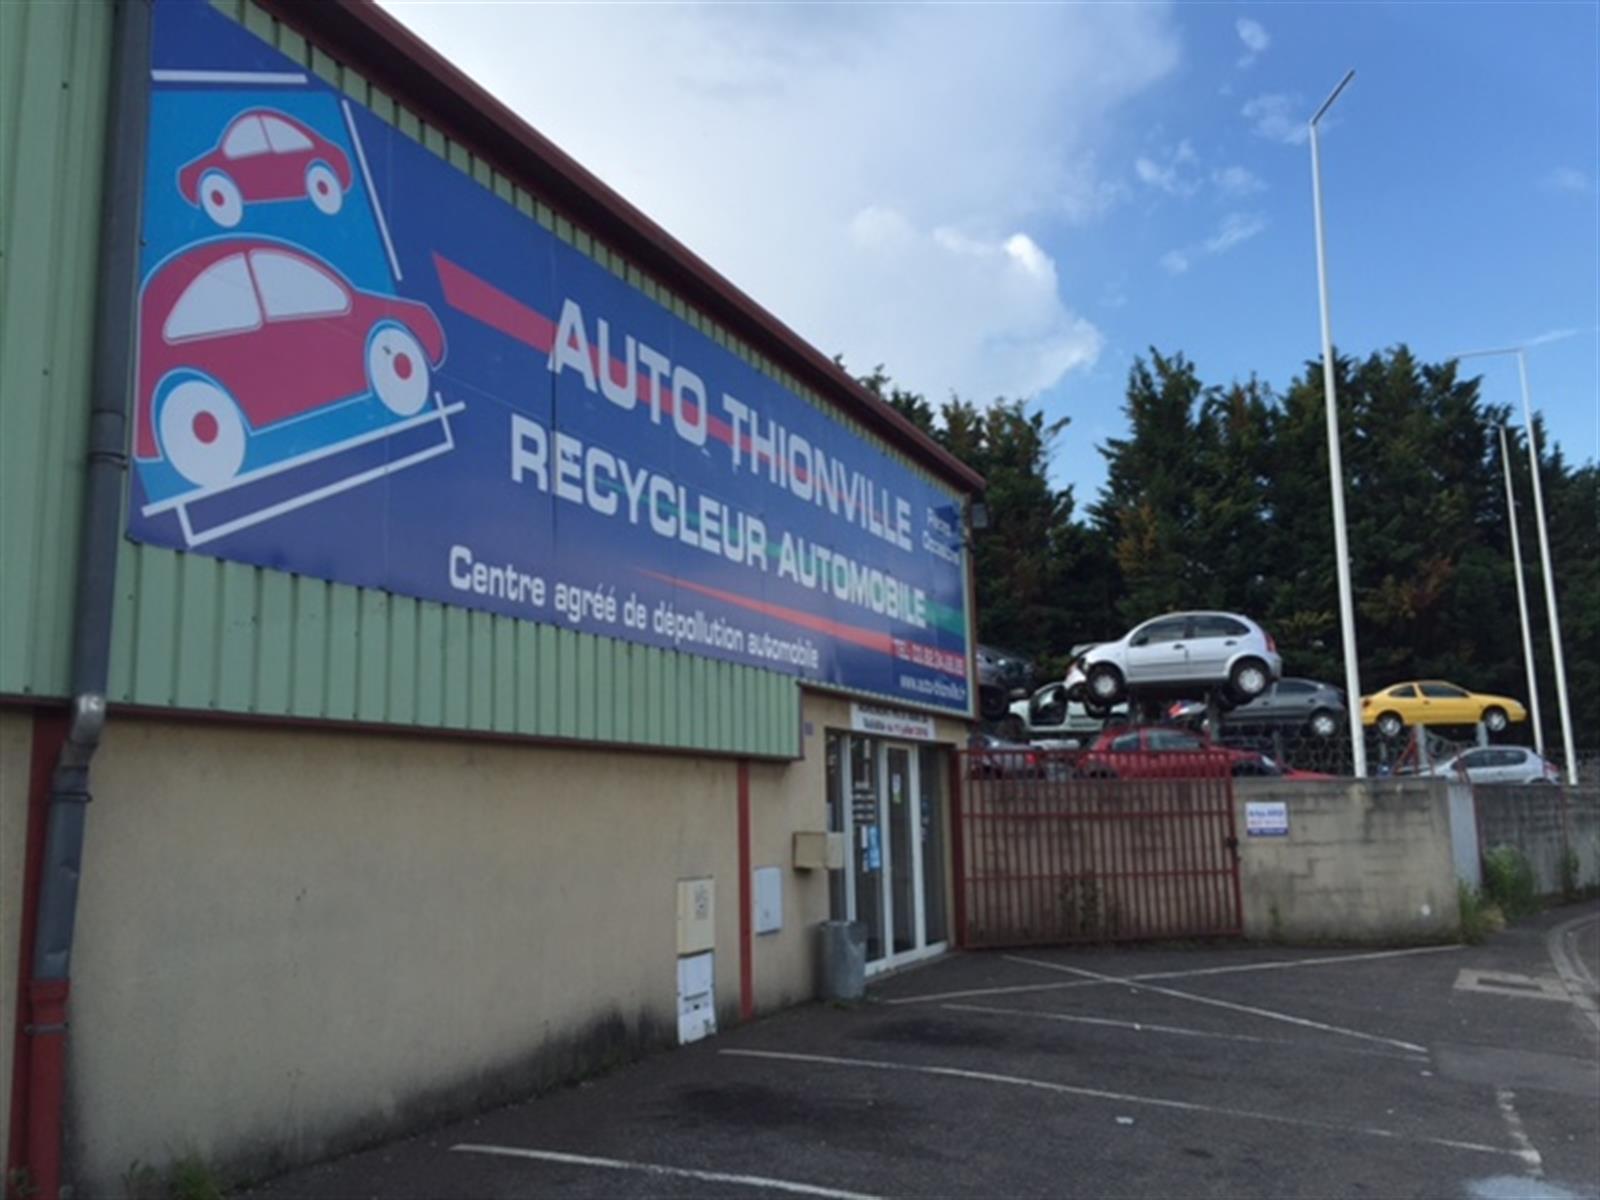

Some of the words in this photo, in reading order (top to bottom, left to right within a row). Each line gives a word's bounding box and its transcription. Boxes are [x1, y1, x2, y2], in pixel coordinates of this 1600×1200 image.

[510, 412, 768, 571] RECYCLEUR
[777, 531, 927, 629] AUTOMOBILE
[547, 297, 708, 446] AUTO
[722, 393, 913, 552] THIONVILLE
[450, 546, 546, 607] Centre
[554, 583, 617, 623] agréé
[623, 593, 648, 630] de
[653, 602, 745, 653] dépollution
[747, 630, 819, 669] automobile
